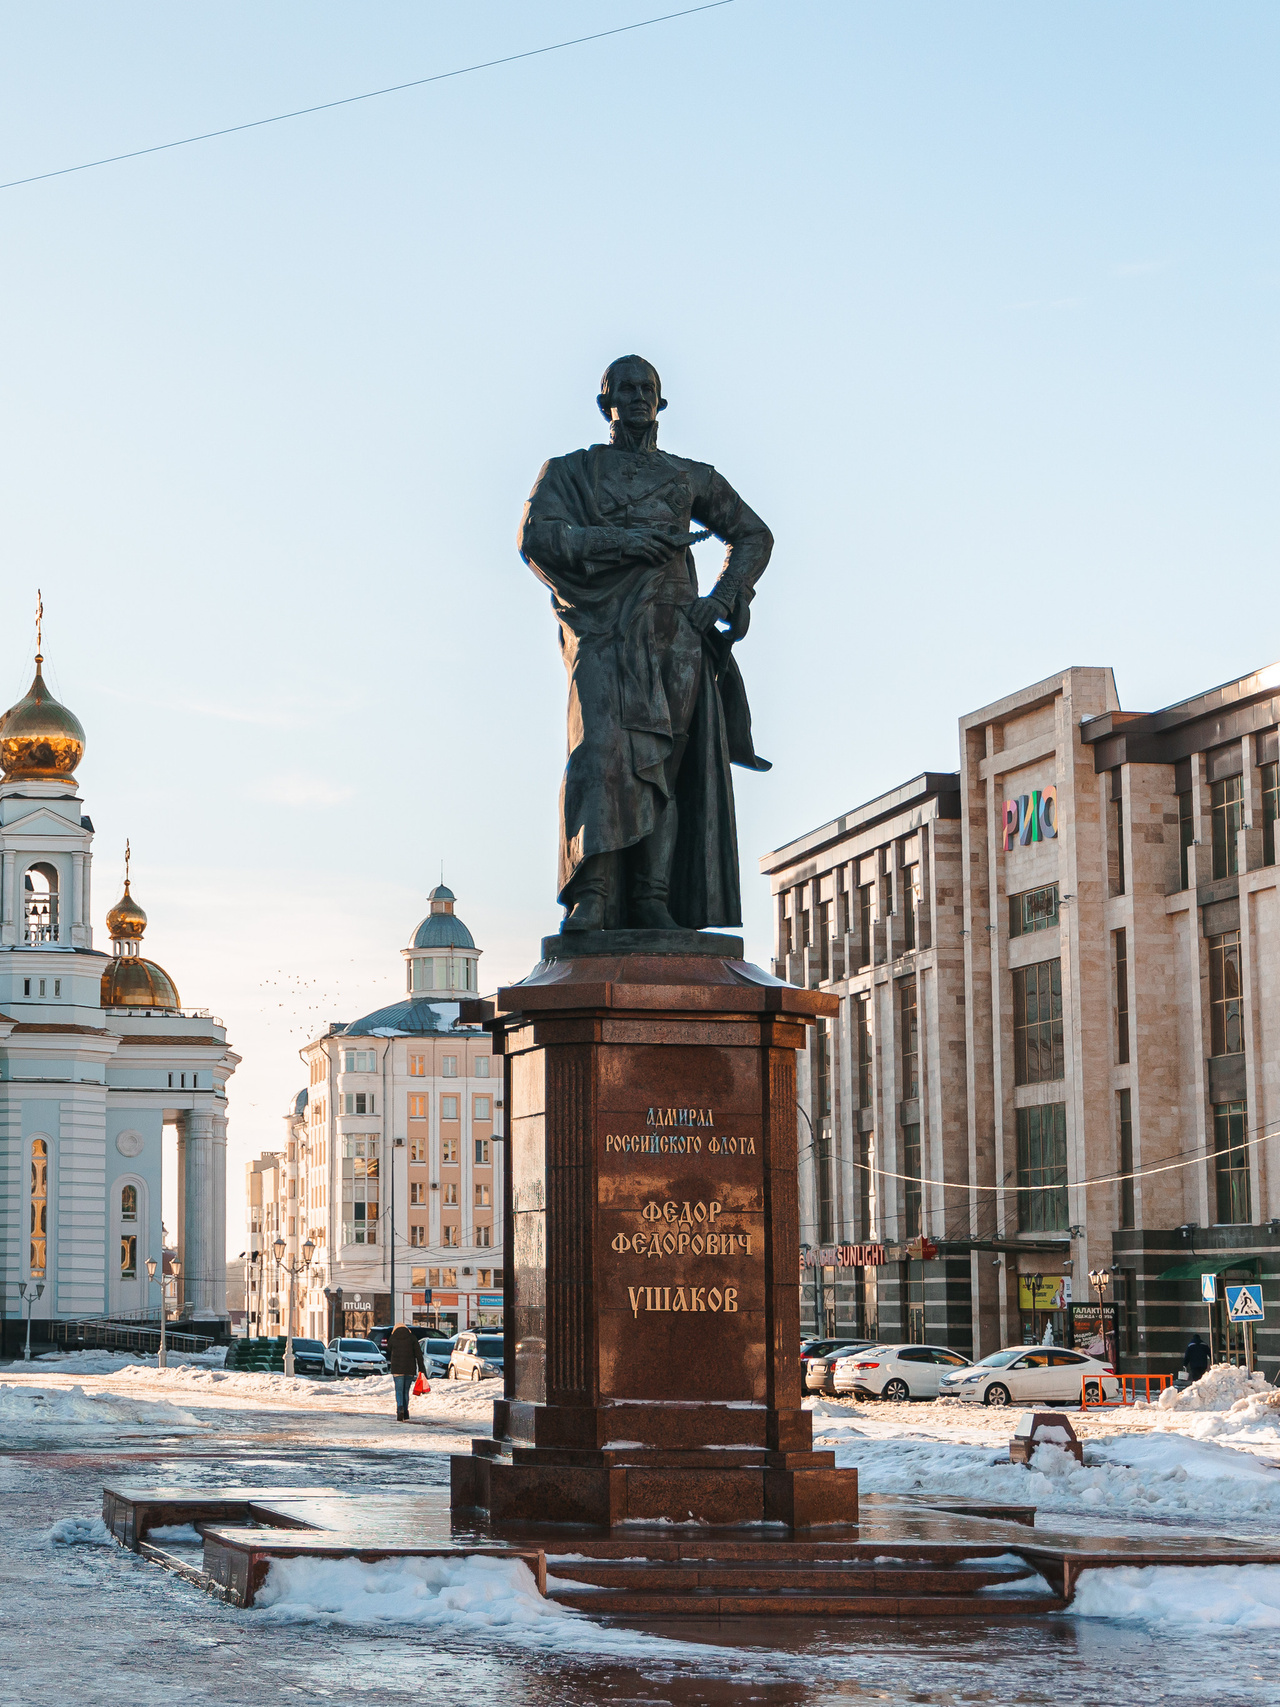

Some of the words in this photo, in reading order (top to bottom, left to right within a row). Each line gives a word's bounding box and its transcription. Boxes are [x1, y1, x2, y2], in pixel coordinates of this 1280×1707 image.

[1002, 785, 1058, 851] РИО
[646, 1107, 714, 1129] АДМИРАЛ
[605, 1131, 702, 1154] РОССИЙСКОГО
[708, 1136, 756, 1155] ФЛОТА
[642, 1201, 722, 1227] ФЕДОР
[611, 1232, 753, 1259] ФЕДОРОВИЧ
[837, 1244, 885, 1266] SUNLIGHT
[344, 1301, 371, 1310] ПТИЦА
[627, 1286, 738, 1318] УШАКОВ
